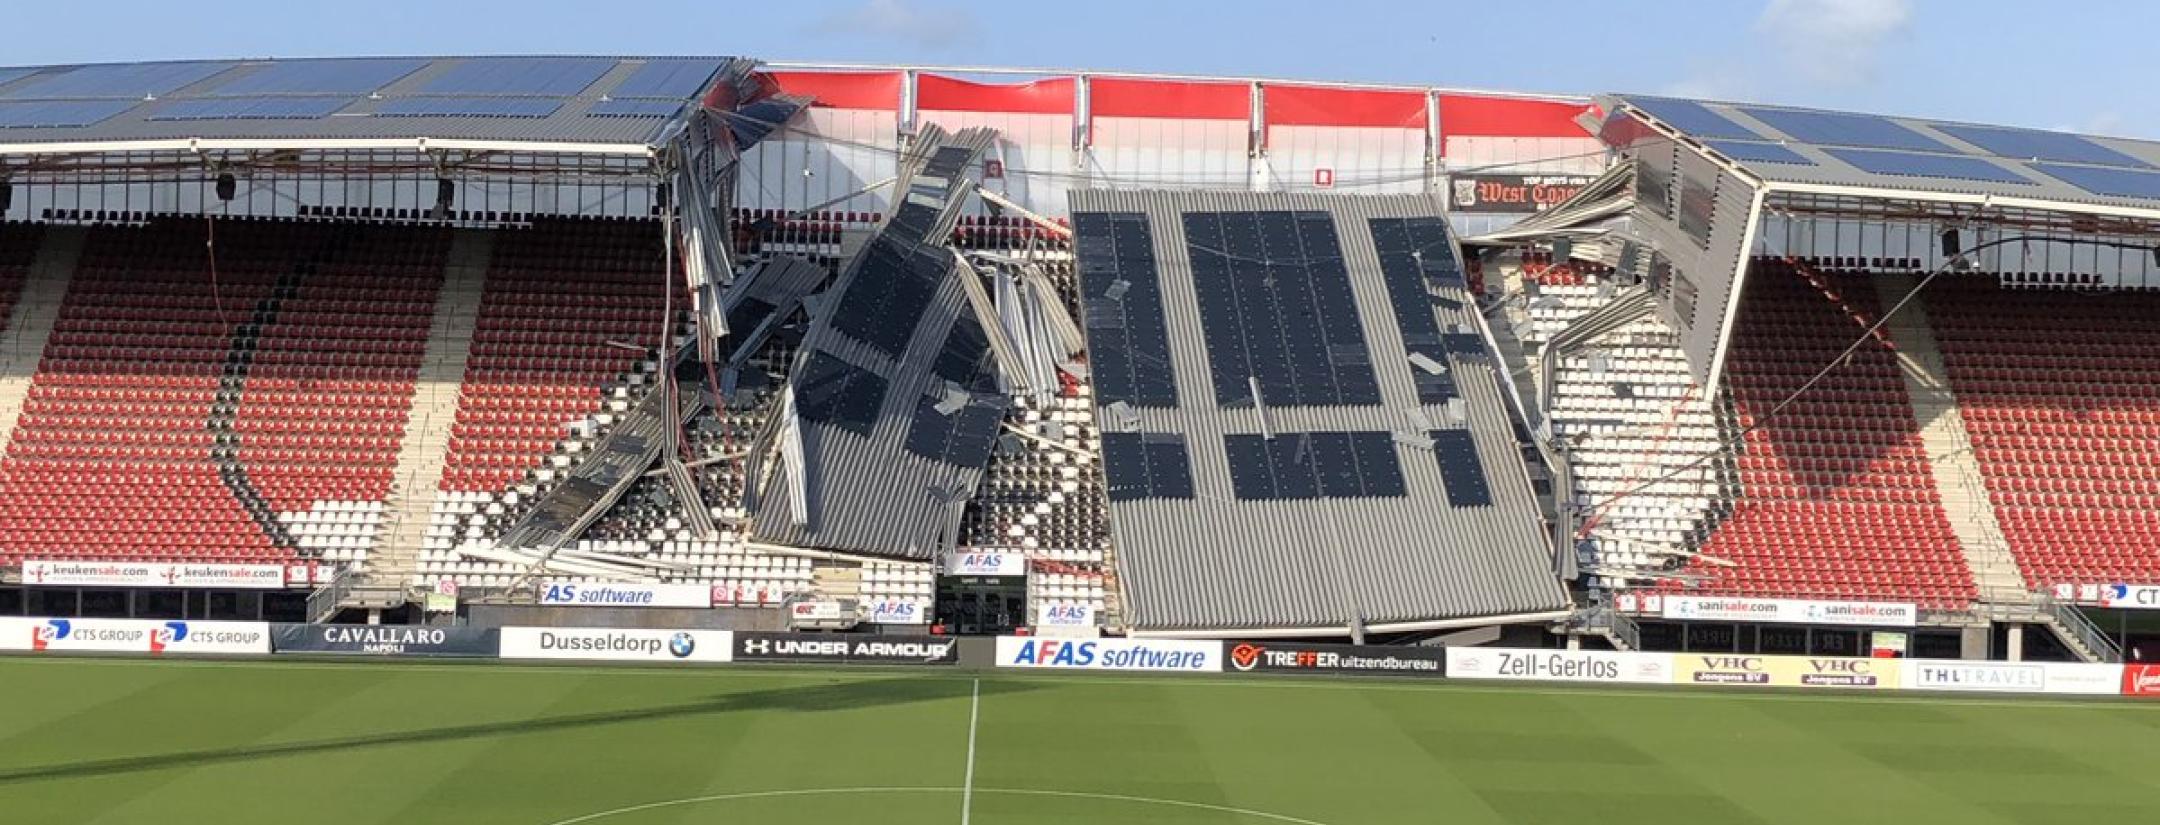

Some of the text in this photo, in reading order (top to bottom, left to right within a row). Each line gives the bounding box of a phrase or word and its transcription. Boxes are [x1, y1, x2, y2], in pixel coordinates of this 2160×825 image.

[1478, 182, 1528, 203] West
[964, 554, 1002, 567] AFAS
[53, 563, 149, 576] keukensale.com
[184, 566, 278, 578] keukensale.com
[579, 588, 653, 604] software
[874, 602, 916, 615] AFAS
[1047, 606, 1086, 619] AFAS
[1698, 600, 1777, 612] sanisale.com
[1825, 604, 1906, 616] sanisale.com
[73, 629, 144, 641] CTS GROUP
[190, 632, 260, 643] CTS GROUP
[324, 628, 446, 645] CAVALLARO
[363, 644, 405, 653] NAPOLI
[540, 631, 662, 654] Dusseldorp
[775, 641, 949, 657] UNDER ARMOUR
[1014, 639, 1206, 668] AFAS software
[1264, 650, 1438, 670] TREFFER uitzendbureau
[1498, 653, 1618, 678] Zell-Gerlos
[1702, 657, 1763, 671] VHC
[1809, 659, 1870, 674] VHC
